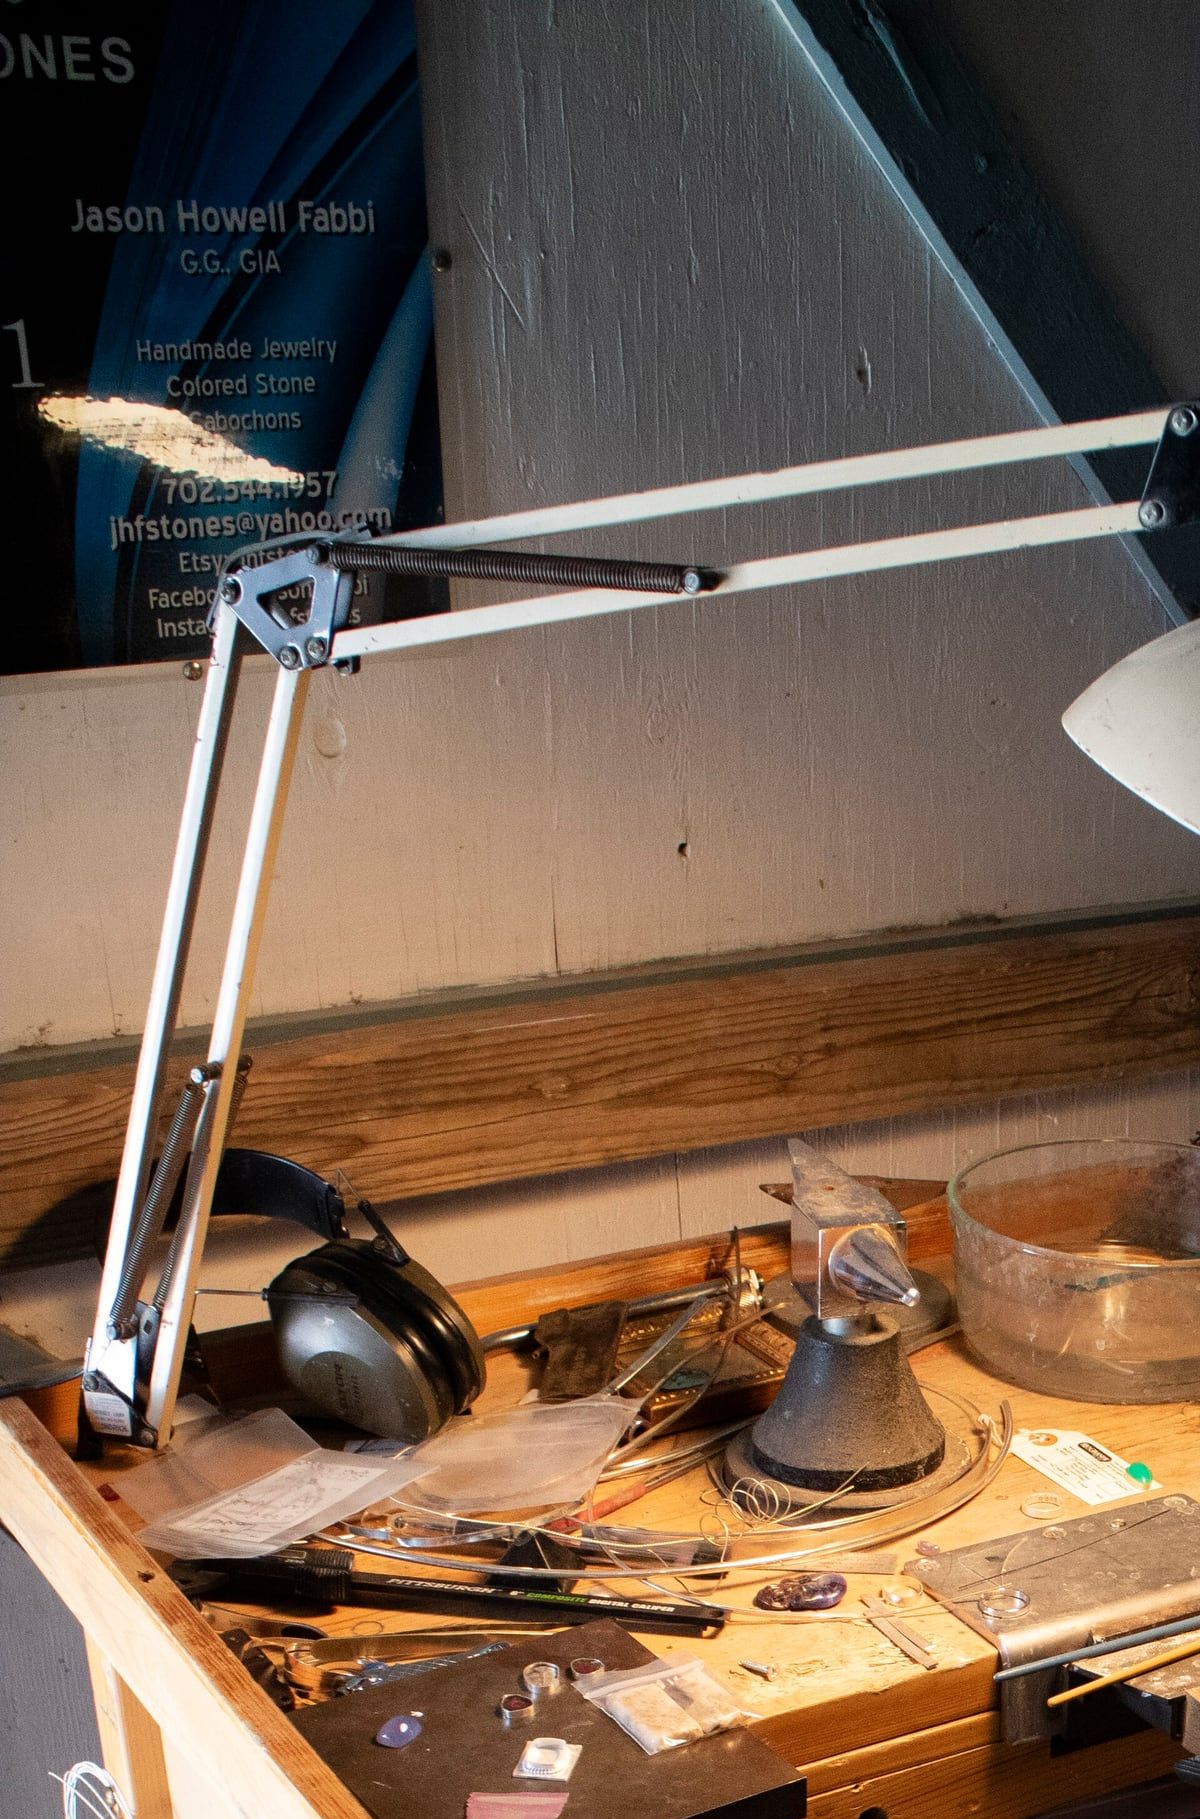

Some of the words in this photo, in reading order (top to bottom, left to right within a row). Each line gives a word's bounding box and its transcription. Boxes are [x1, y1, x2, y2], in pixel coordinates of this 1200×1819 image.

[71, 198, 166, 234] Jason
[176, 199, 288, 234] Howell
[298, 199, 375, 233] Fabbi
[239, 248, 282, 275] GIA
[136, 338, 253, 362] Handmade
[260, 337, 338, 363] Jewelry
[166, 375, 248, 398] Colored
[255, 373, 316, 395] Stone
[386, 1577, 495, 1594] PITTSBURGH
[526, 1591, 588, 1604] COMPOSITE
[588, 1598, 630, 1609] DIGITAL
[630, 1602, 676, 1614] CALIPER
